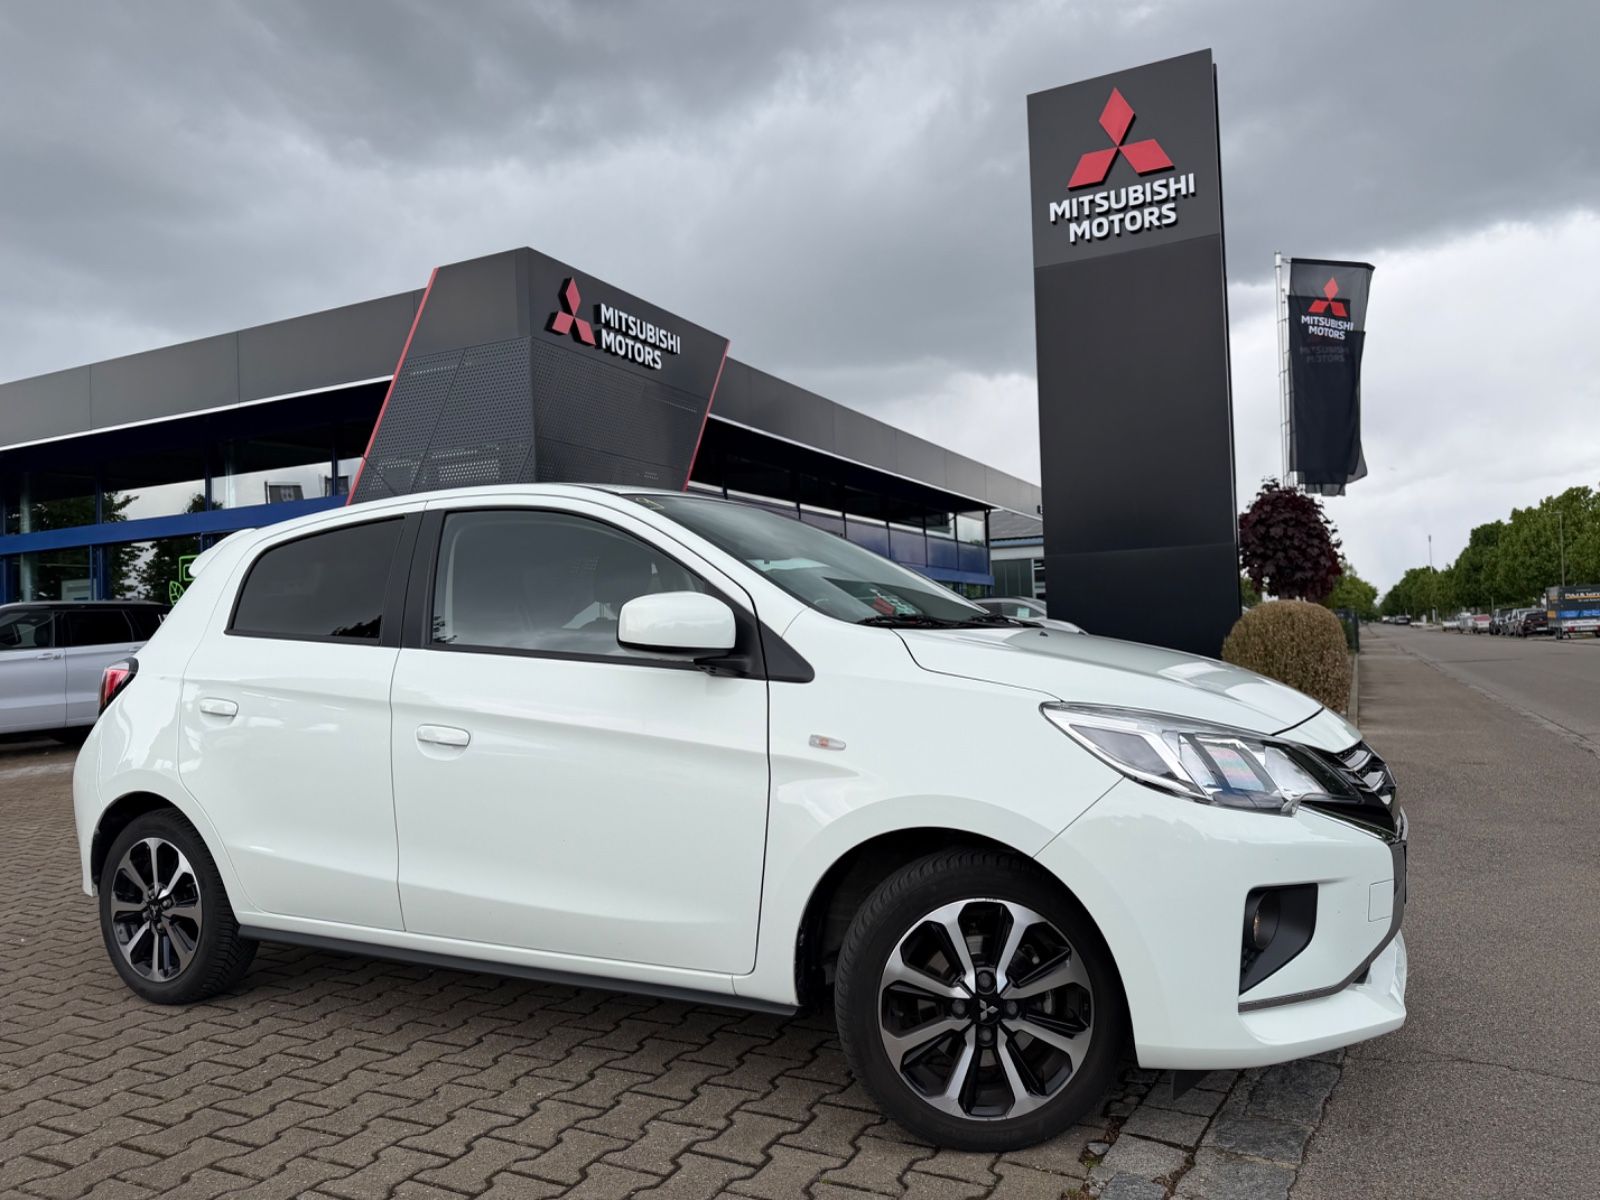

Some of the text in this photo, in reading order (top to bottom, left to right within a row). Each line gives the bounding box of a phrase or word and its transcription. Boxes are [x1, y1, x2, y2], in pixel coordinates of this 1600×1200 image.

[1049, 172, 1195, 222] MITSUBISHI
[1069, 203, 1177, 243] MOTORS
[600, 303, 681, 354] MITSUBISHI
[1301, 315, 1354, 331] MITSUBISHI
[1308, 325, 1346, 340] MOTORS
[601, 328, 662, 370] MOTORS
